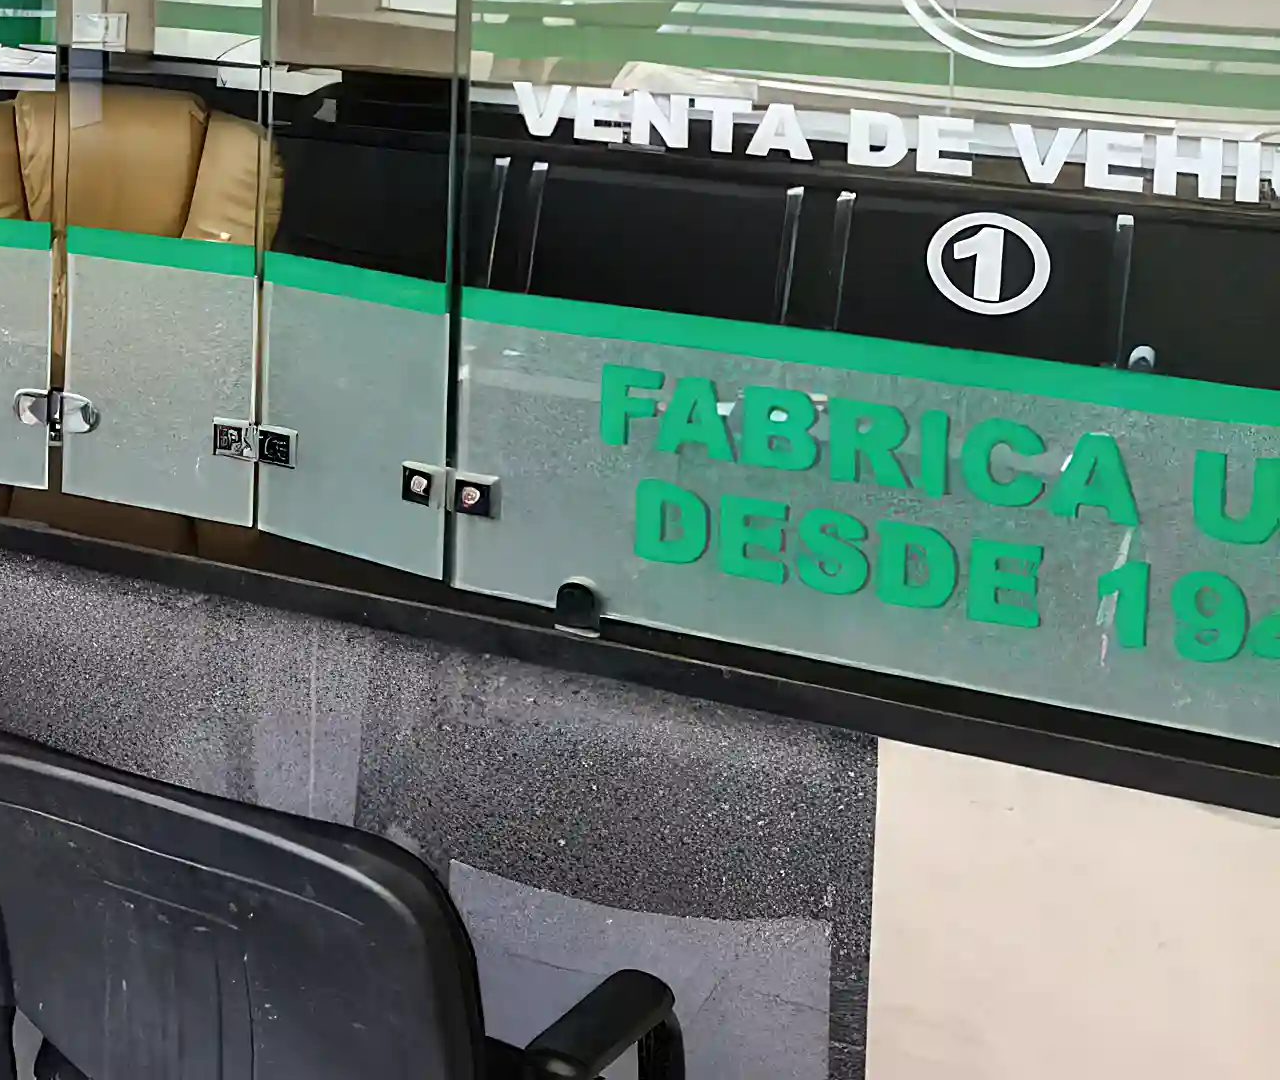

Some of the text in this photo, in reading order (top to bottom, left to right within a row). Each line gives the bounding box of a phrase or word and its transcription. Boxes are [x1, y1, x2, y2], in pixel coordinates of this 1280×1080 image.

[512, 81, 1280, 204] VENTA DE VEHI
[600, 364, 1140, 527] FABRICA
[634, 478, 1045, 629] DESDE
